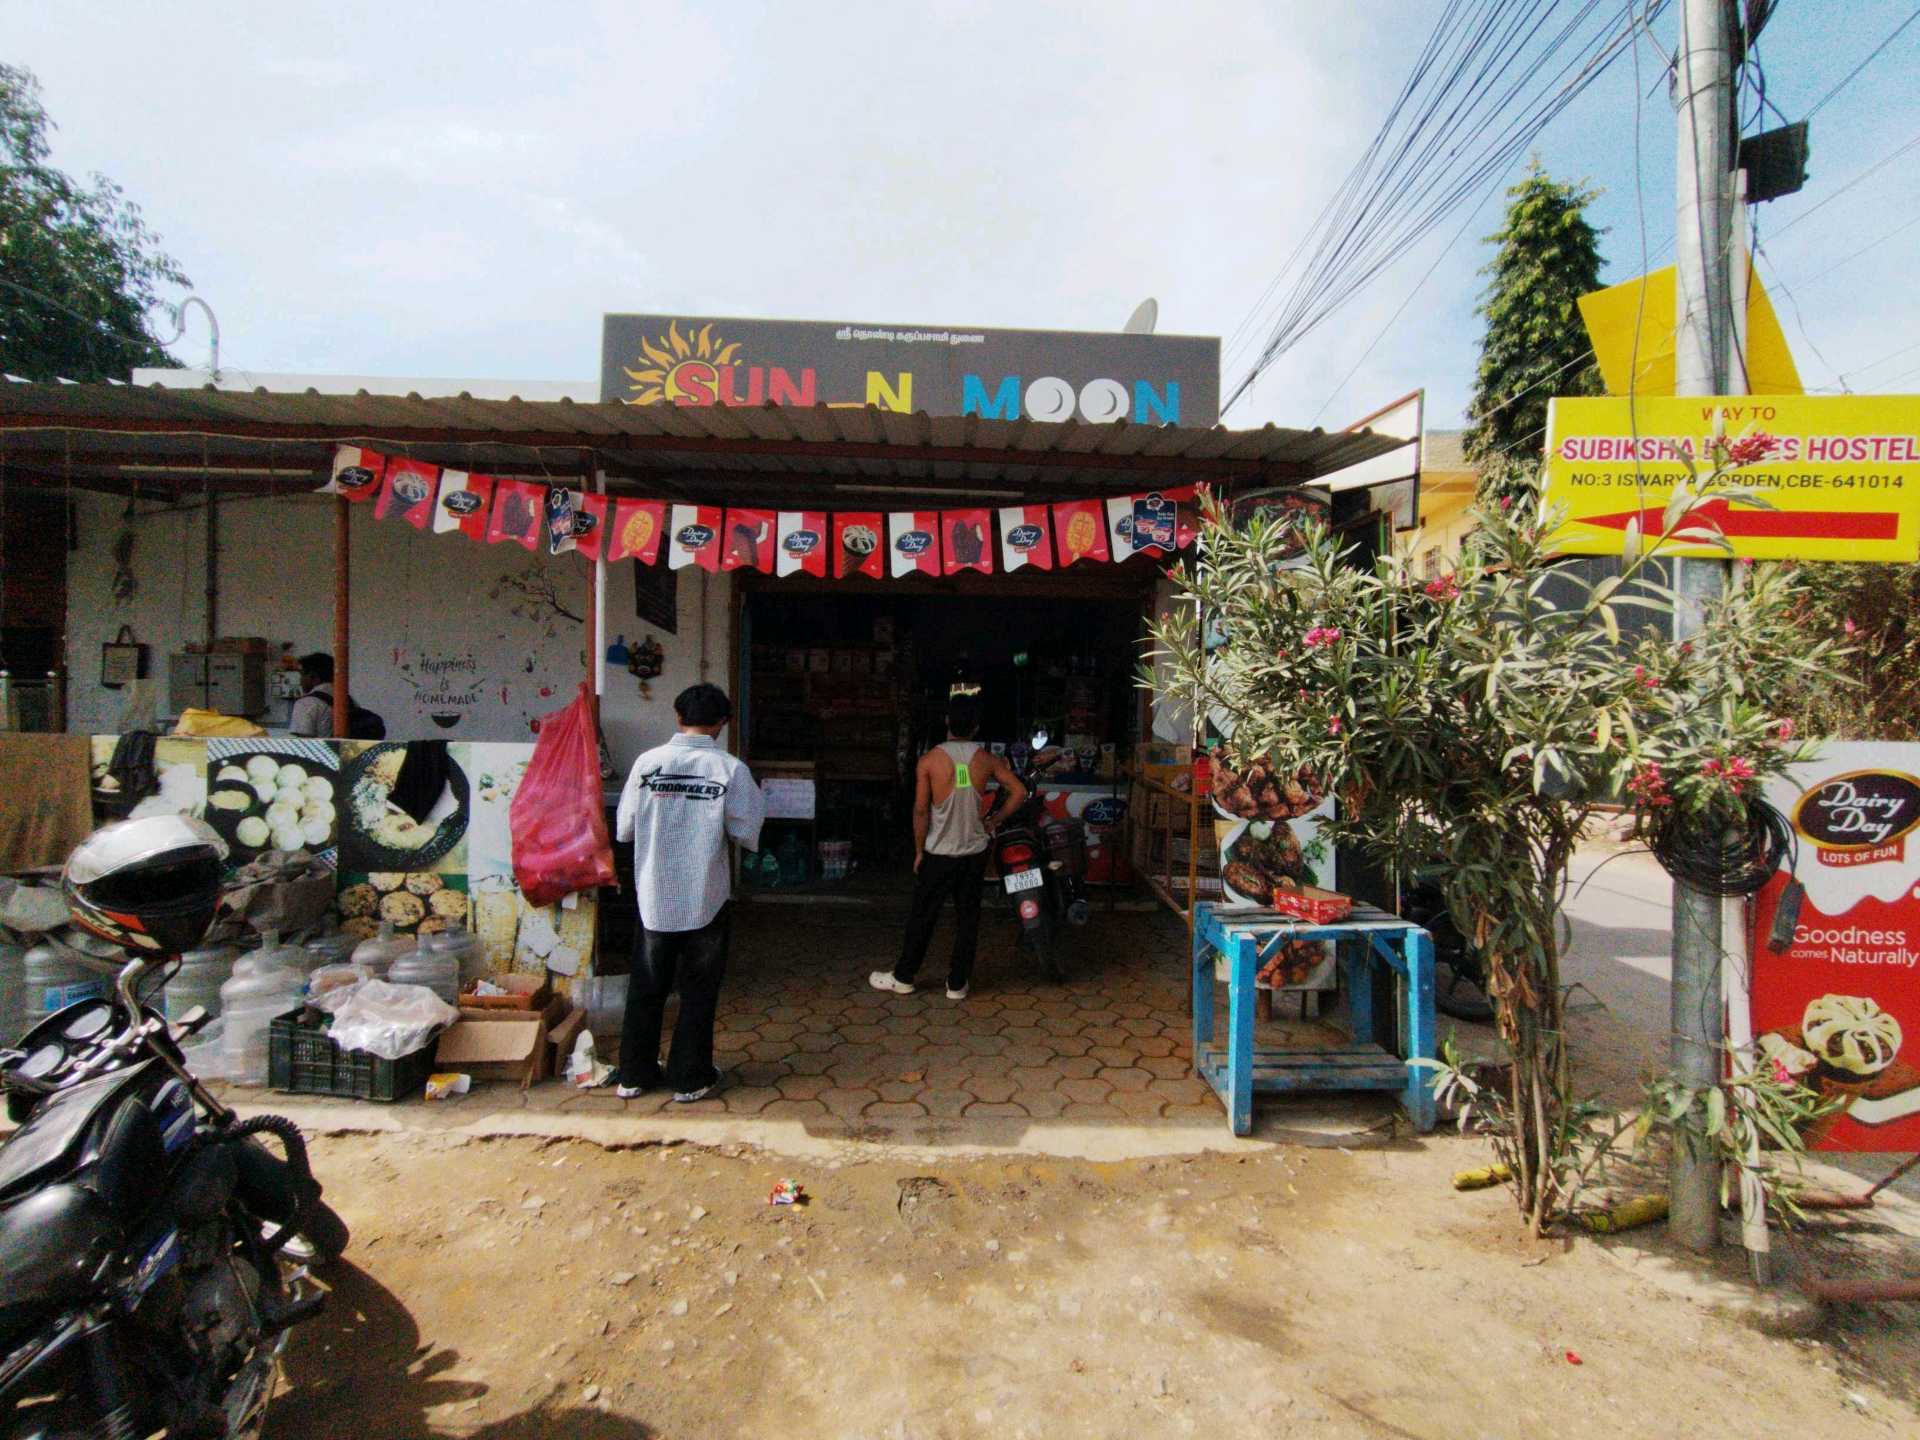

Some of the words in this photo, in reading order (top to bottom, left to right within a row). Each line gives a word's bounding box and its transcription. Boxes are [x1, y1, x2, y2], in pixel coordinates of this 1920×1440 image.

[674, 363, 816, 408] SUN
[866, 371, 913, 415] N
[961, 374, 1181, 425] MOON
[1702, 406, 1743, 421] WAY
[1751, 406, 1777, 421] TO
[1563, 437, 1696, 461] SUBIKSHA
[1807, 437, 1920, 462] HOSTEL
[1571, 472, 1612, 487] NO:3
[682, 526, 708, 539] Dairy
[685, 533, 705, 546] Day
[788, 532, 813, 545] Dairy
[901, 533, 927, 546] Dairy
[1012, 527, 1037, 539] Dairy
[791, 540, 810, 552] Day
[904, 541, 924, 553] Day
[1015, 535, 1035, 546] Day
[1818, 781, 1906, 818] Dairy
[1827, 807, 1894, 844] Day
[1822, 850, 1851, 865] LOTS
[1853, 849, 1870, 862] OF
[1872, 845, 1898, 860] FUN
[1793, 924, 1906, 945] Goodness
[1791, 949, 1829, 960] comes
[1830, 947, 1919, 968] Naturally
